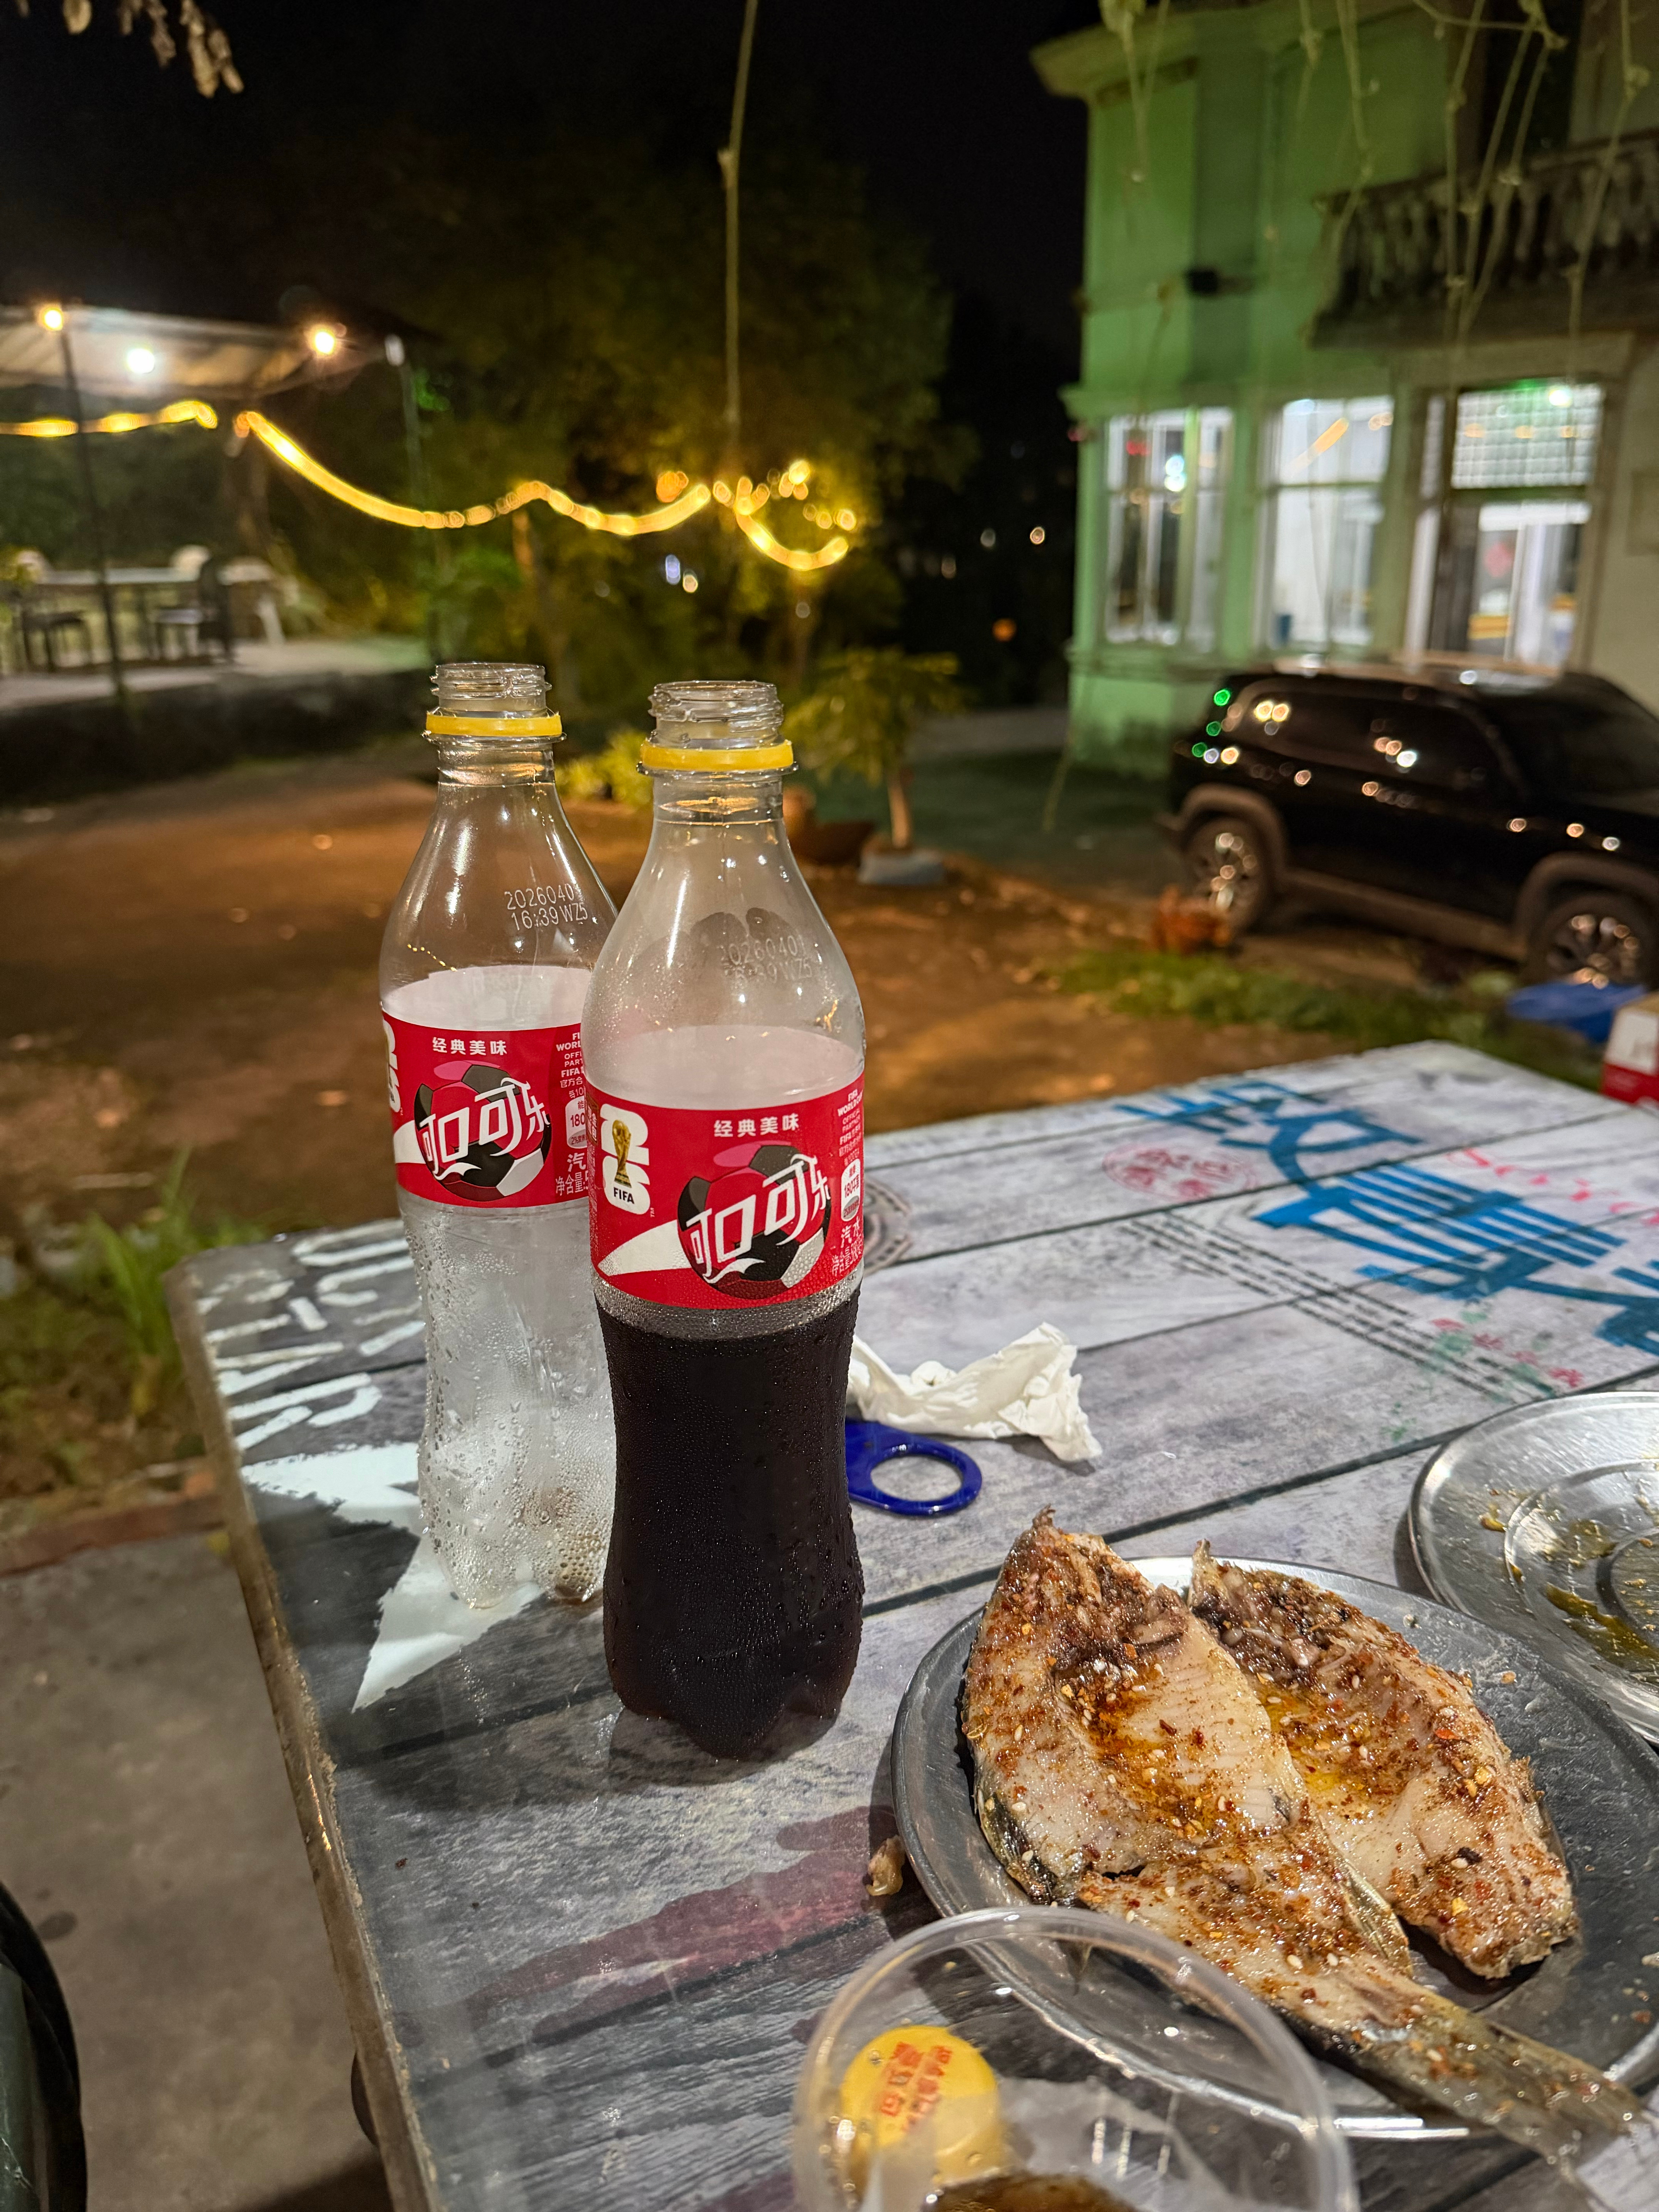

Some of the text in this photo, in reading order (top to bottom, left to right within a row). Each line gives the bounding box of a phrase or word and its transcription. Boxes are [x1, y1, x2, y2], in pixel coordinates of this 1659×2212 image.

[504, 883, 584, 910] 2026040
[559, 902, 588, 922] WZ5
[572, 1032, 580, 1041] FI
[432, 1037, 507, 1056] 经典美味
[556, 1041, 581, 1052] WORL
[564, 1051, 582, 1060] OFFI
[564, 1058, 583, 1067] PART
[561, 1067, 580, 1078] FIFA
[560, 1077, 583, 1088] 官方合
[419, 1077, 551, 1180] 可口可乐
[570, 1112, 586, 1127] 180
[713, 1113, 799, 1138] 经典美味
[567, 1152, 586, 1172] 汽
[613, 1186, 635, 1204] FIFA
[686, 1154, 831, 1284] 可口可乐
[841, 1216, 860, 1248] 汽水
